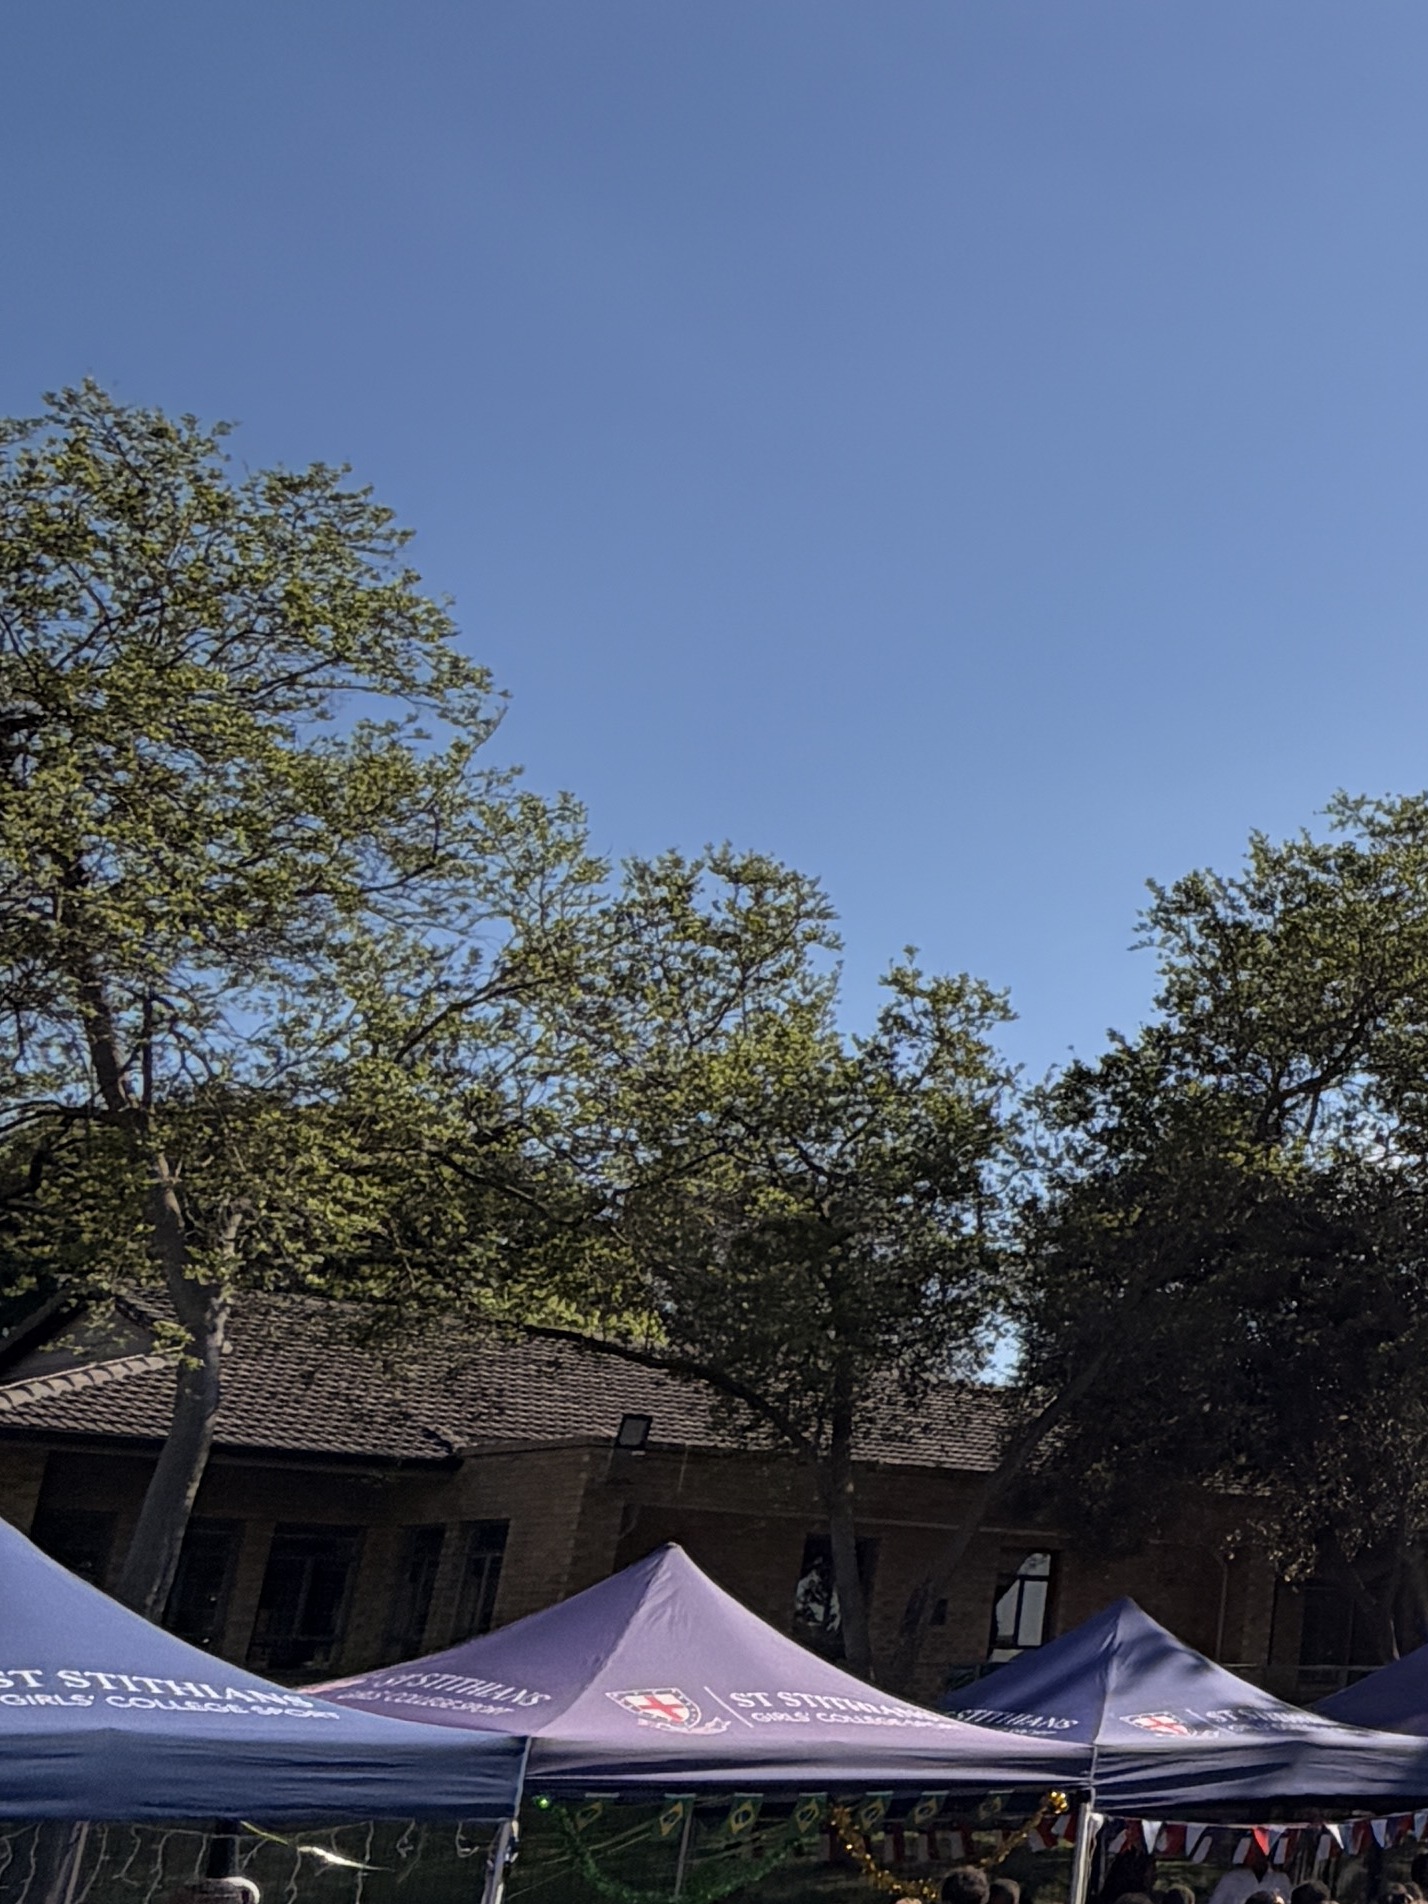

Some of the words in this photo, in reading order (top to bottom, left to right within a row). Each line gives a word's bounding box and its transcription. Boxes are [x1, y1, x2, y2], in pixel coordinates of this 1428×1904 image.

[57, 1670, 314, 1708] STITHIANS
[407, 1673, 551, 1707] STITHIANS
[730, 1692, 773, 1708] ST
[106, 1695, 250, 1715] COLLEGE
